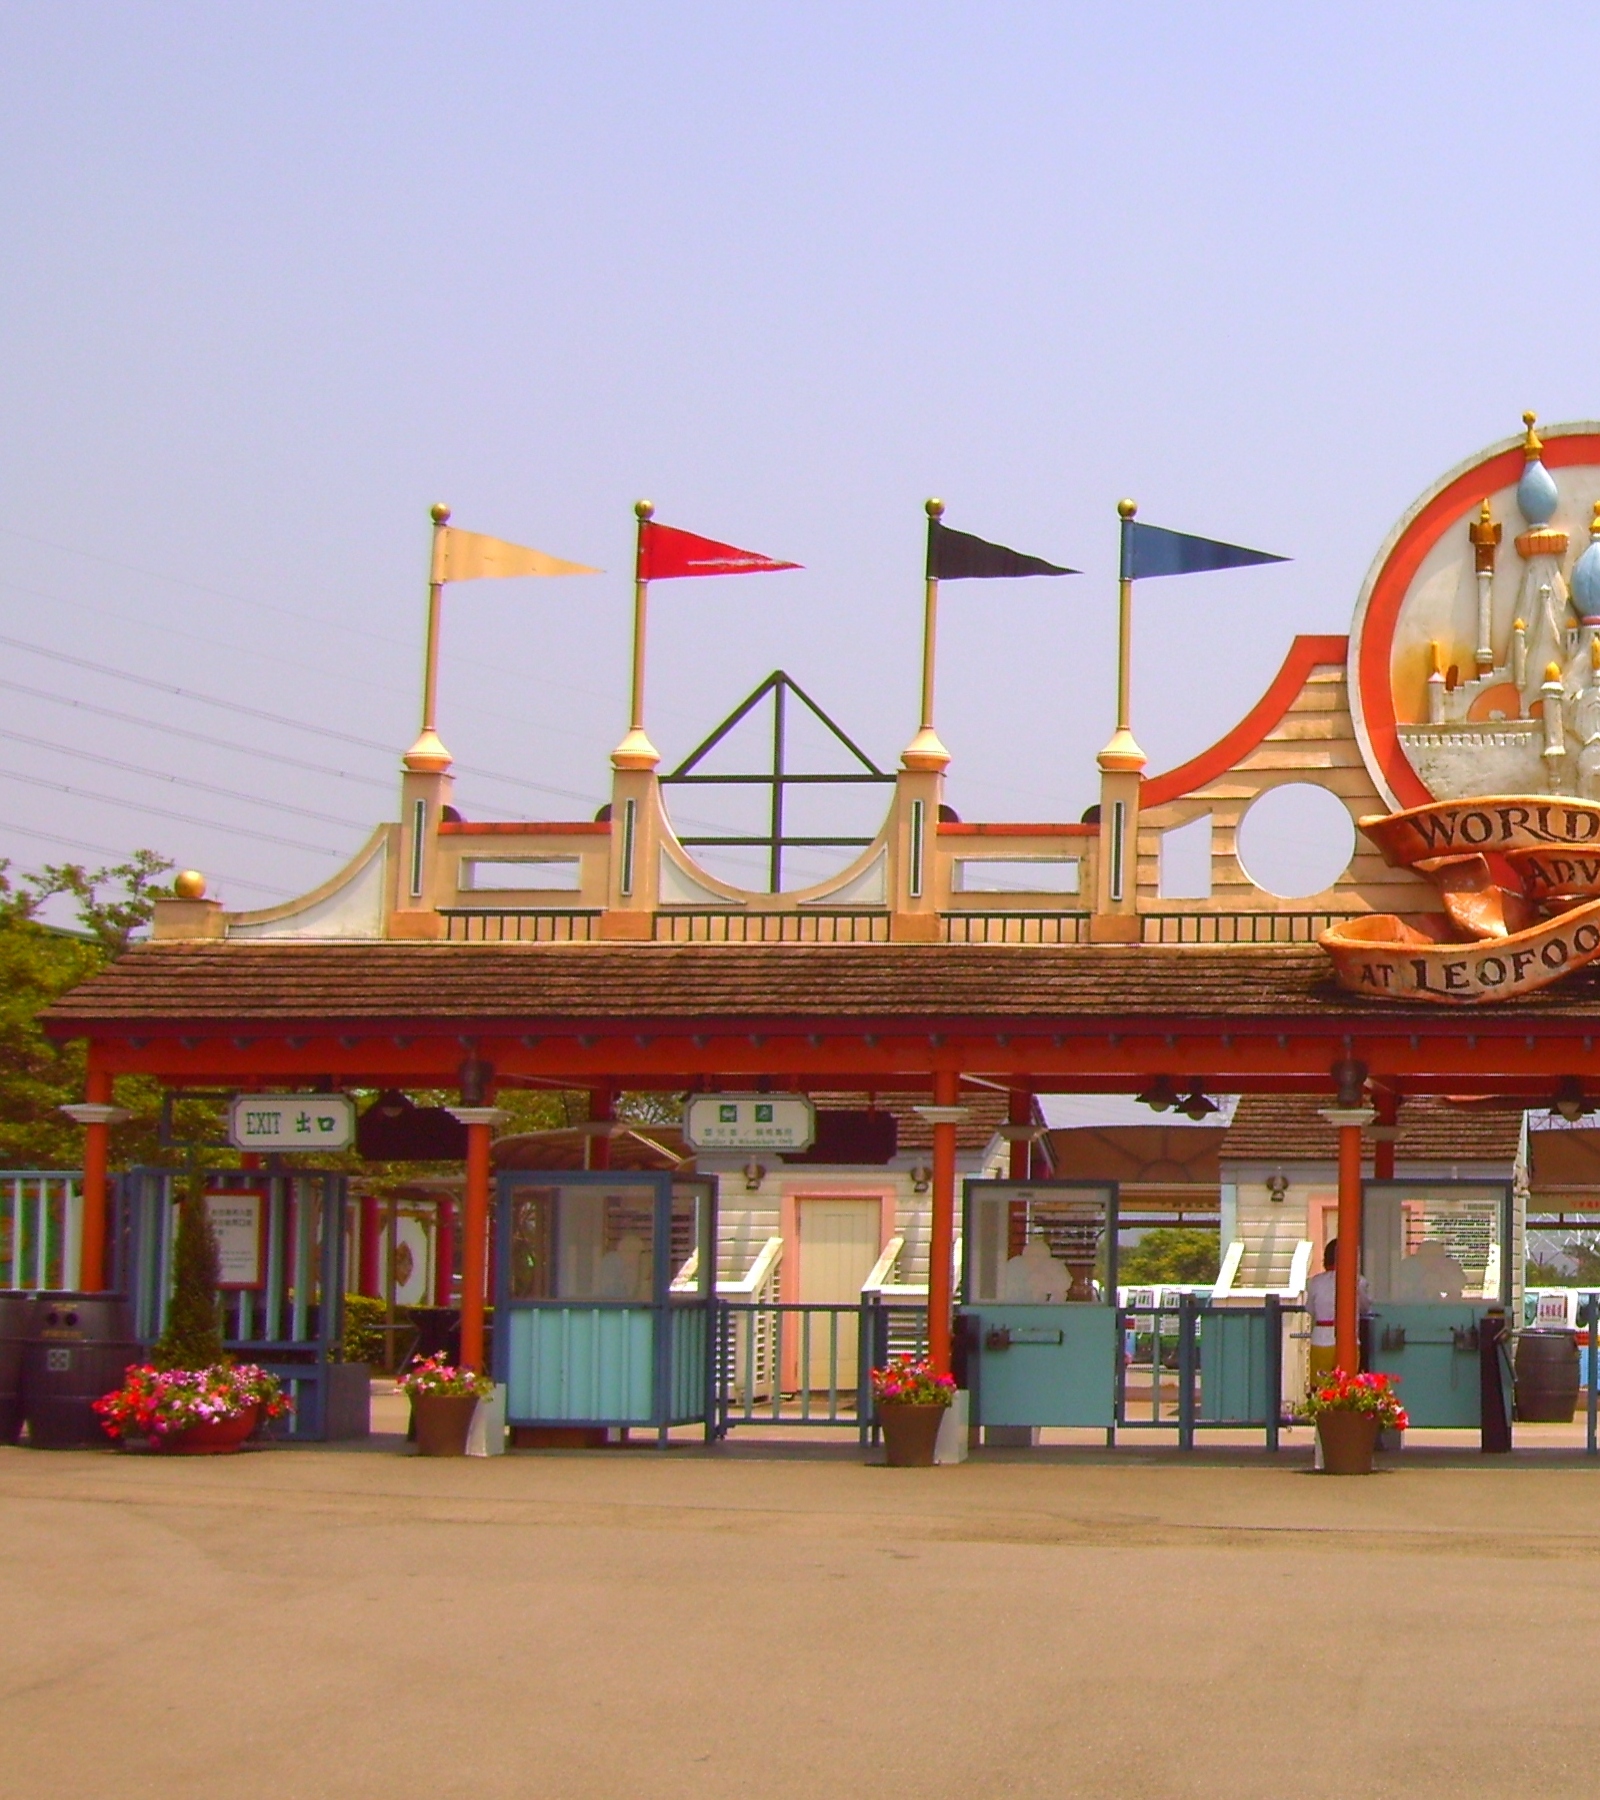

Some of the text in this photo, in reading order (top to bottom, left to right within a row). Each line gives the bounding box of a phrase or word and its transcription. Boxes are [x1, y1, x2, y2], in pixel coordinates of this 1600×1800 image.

[1406, 806, 1600, 850] WORLD
[1360, 922, 1600, 997] AT LEOFOO
[246, 1111, 281, 1134] EXIT
[296, 1111, 335, 1133] 出口
